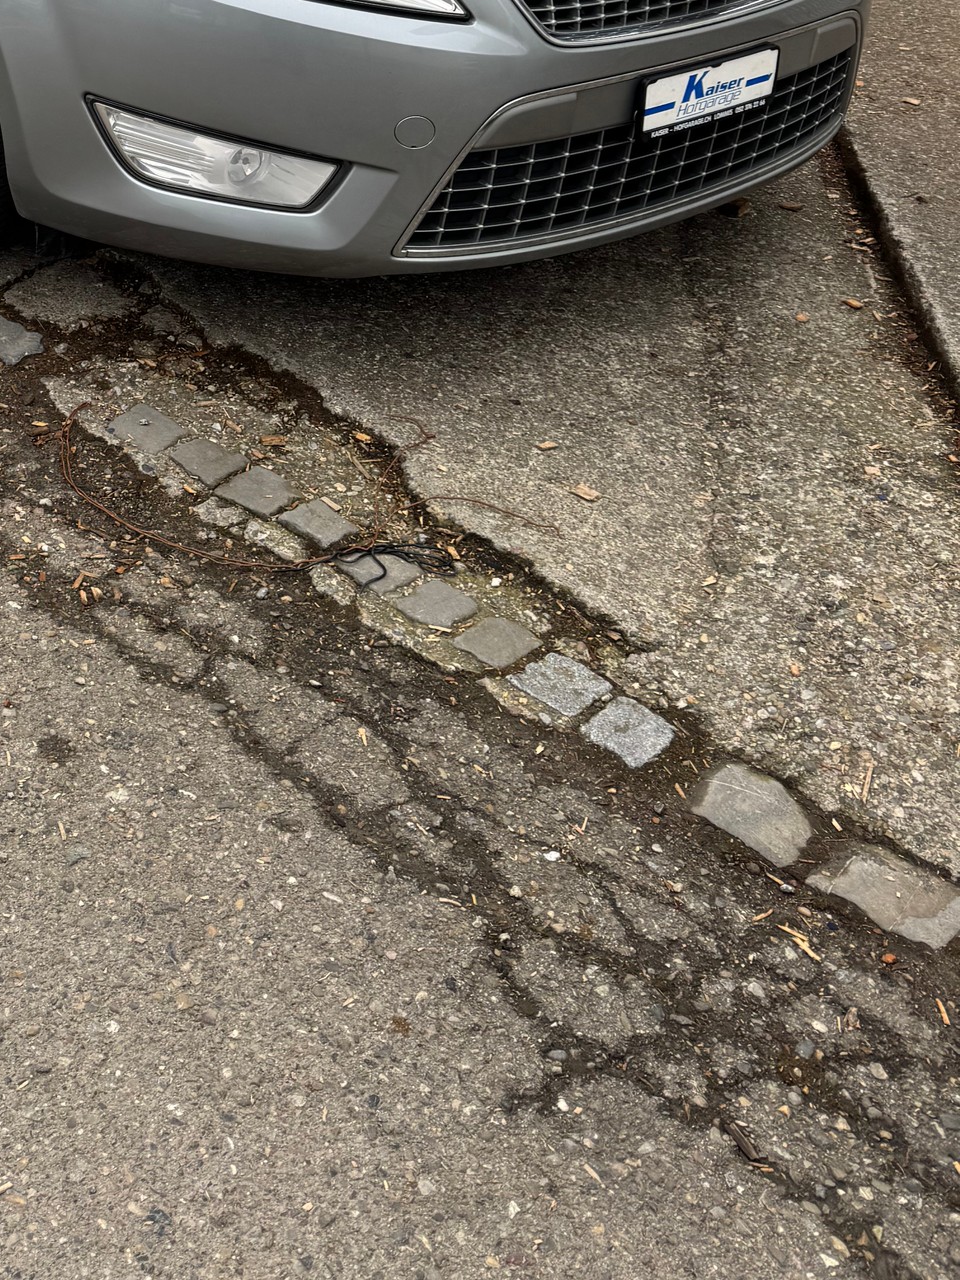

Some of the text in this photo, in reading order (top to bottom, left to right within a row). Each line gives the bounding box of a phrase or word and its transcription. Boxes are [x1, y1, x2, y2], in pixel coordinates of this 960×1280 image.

[681, 70, 745, 104] Kaiser
[676, 90, 742, 119] Hofgarage
[650, 128, 669, 138] KAISER
